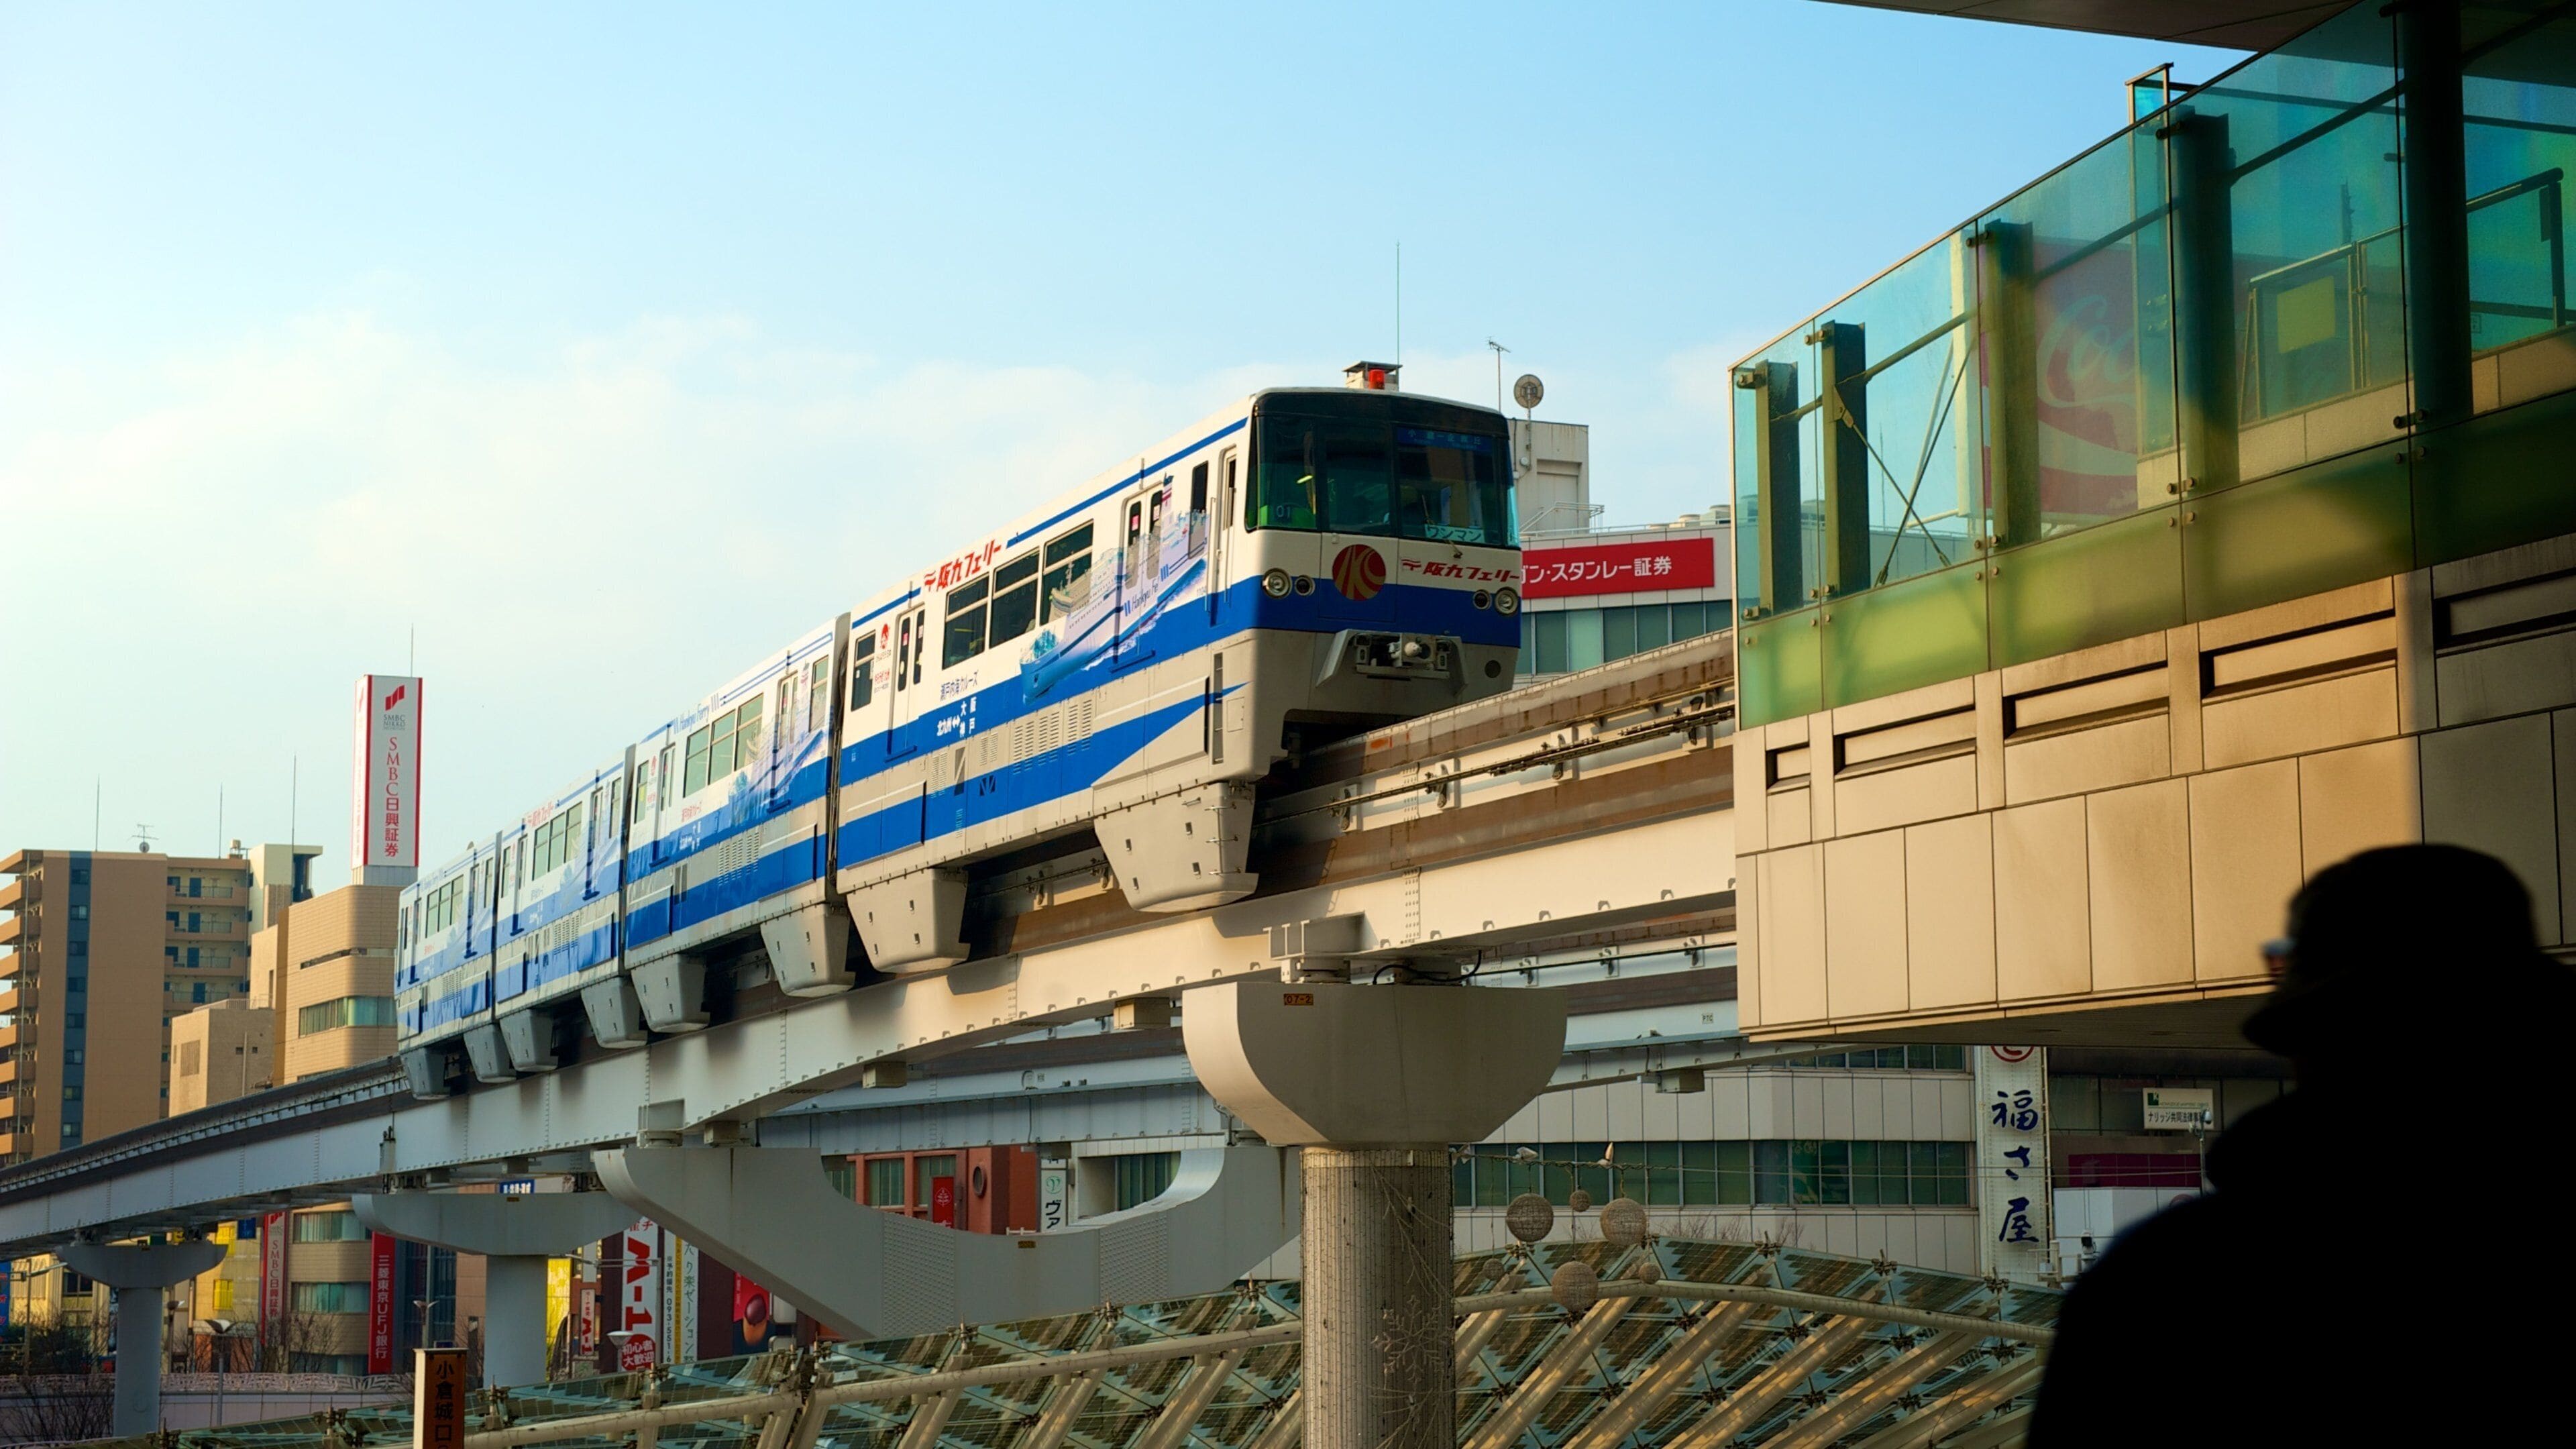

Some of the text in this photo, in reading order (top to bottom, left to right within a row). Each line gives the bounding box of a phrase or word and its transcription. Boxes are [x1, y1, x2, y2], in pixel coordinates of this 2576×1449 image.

[1427, 526, 1482, 541] ワンマン
[936, 539, 1002, 592] 阪九フェリー
[1423, 561, 1521, 582] 阪九フェリー
[384, 737, 400, 857] SMBC日興証券
[1286, 996, 1310, 1004] 07-2
[2148, 1111, 2202, 1123] ナリッジ共同法律事
[1992, 1089, 2039, 1243] 福さ屋
[1045, 1199, 1062, 1229] ヴァ
[376, 1254, 390, 1359] 三菱東京UFJ銀行
[435, 1360, 455, 1441] 小倉城口
